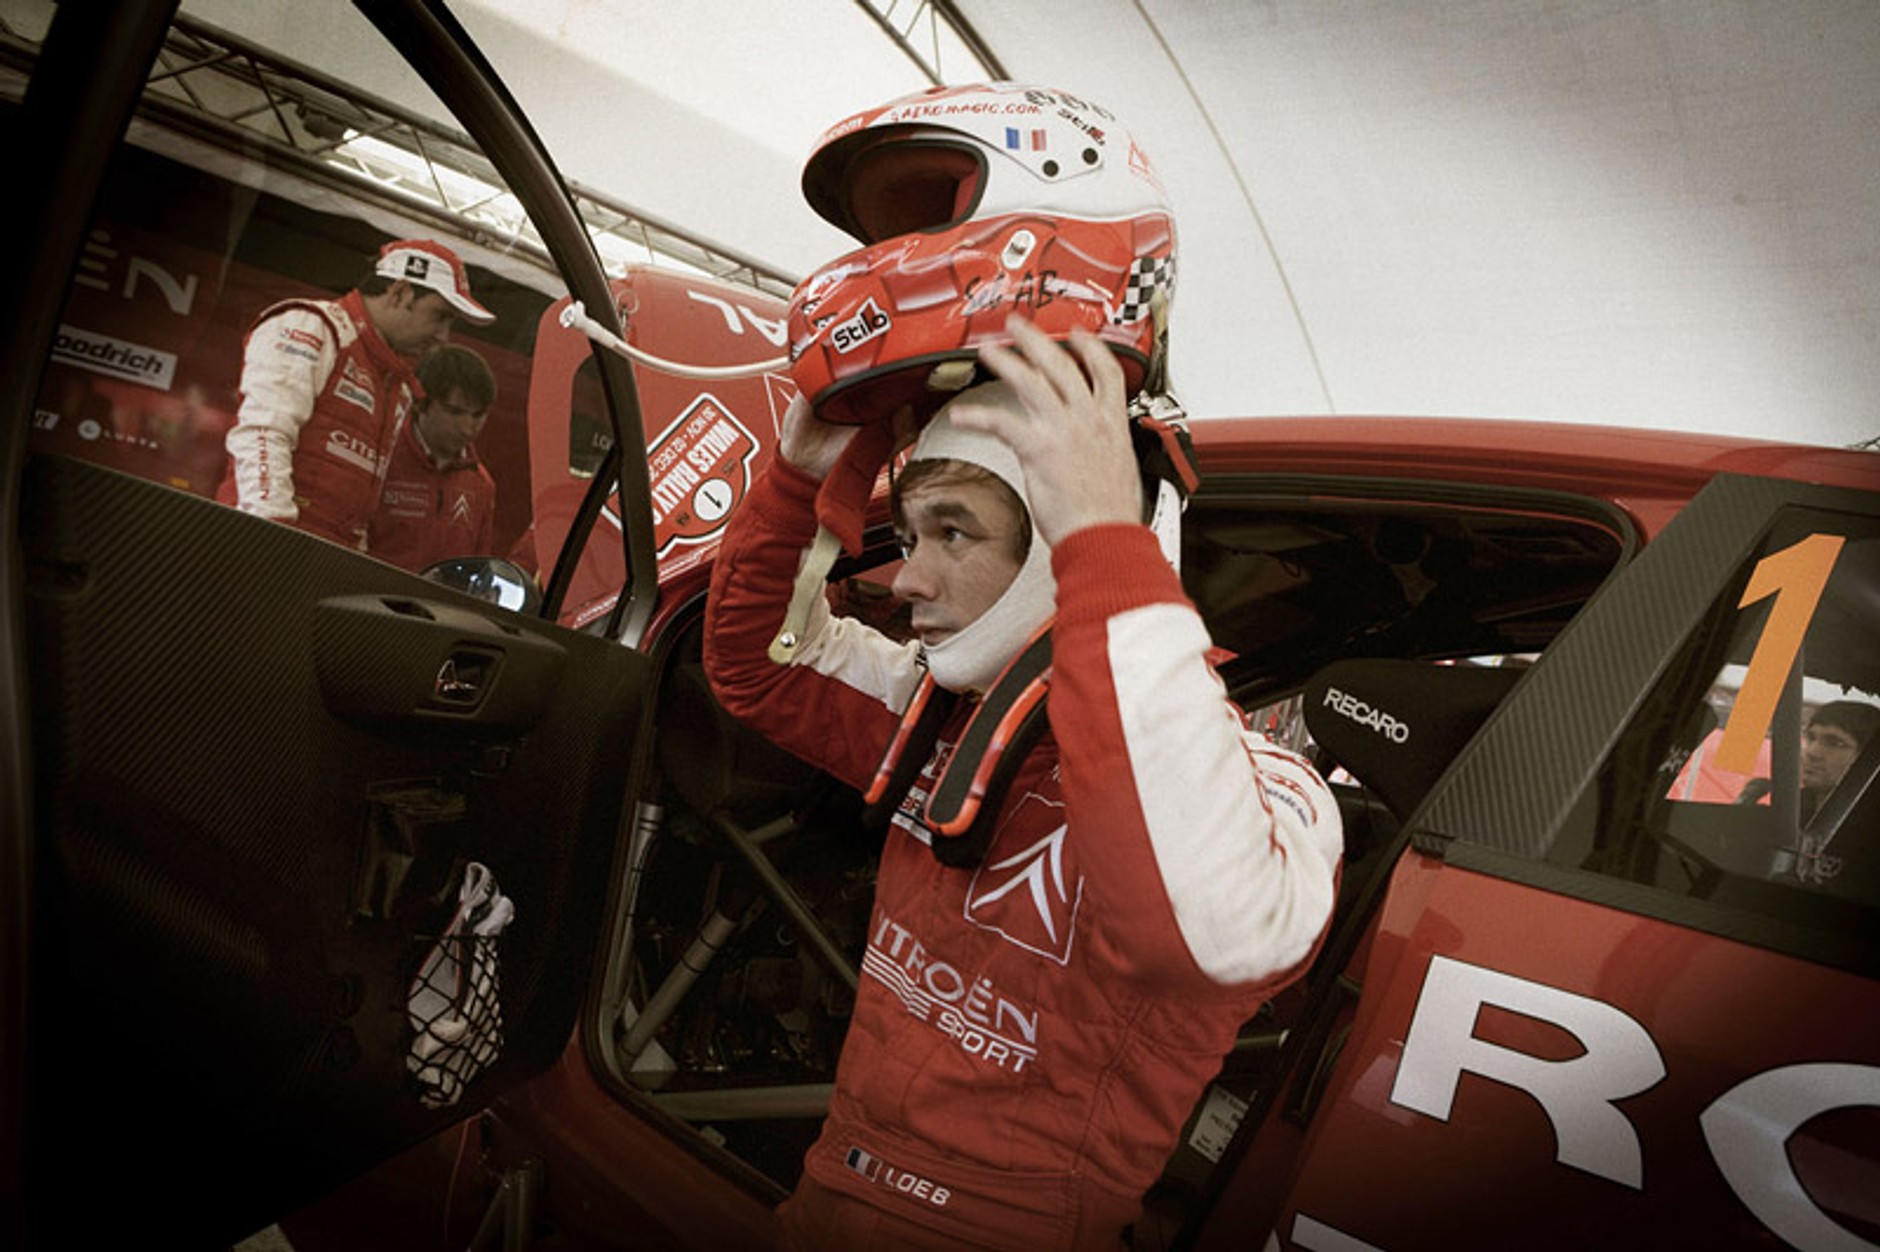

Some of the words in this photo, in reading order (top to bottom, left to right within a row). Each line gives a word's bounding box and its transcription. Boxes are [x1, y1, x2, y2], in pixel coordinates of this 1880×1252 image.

[834, 310, 888, 350] Stilo
[652, 446, 677, 471] DEC
[686, 417, 740, 474] WALES
[651, 459, 701, 514] RALLY
[702, 489, 723, 509] 1
[1713, 533, 1846, 776] 1
[1323, 687, 1409, 743] RECARO
[874, 911, 1038, 1043] ITROËN
[936, 1011, 1036, 1073] SPORT
[885, 1167, 951, 1206] LOEB
